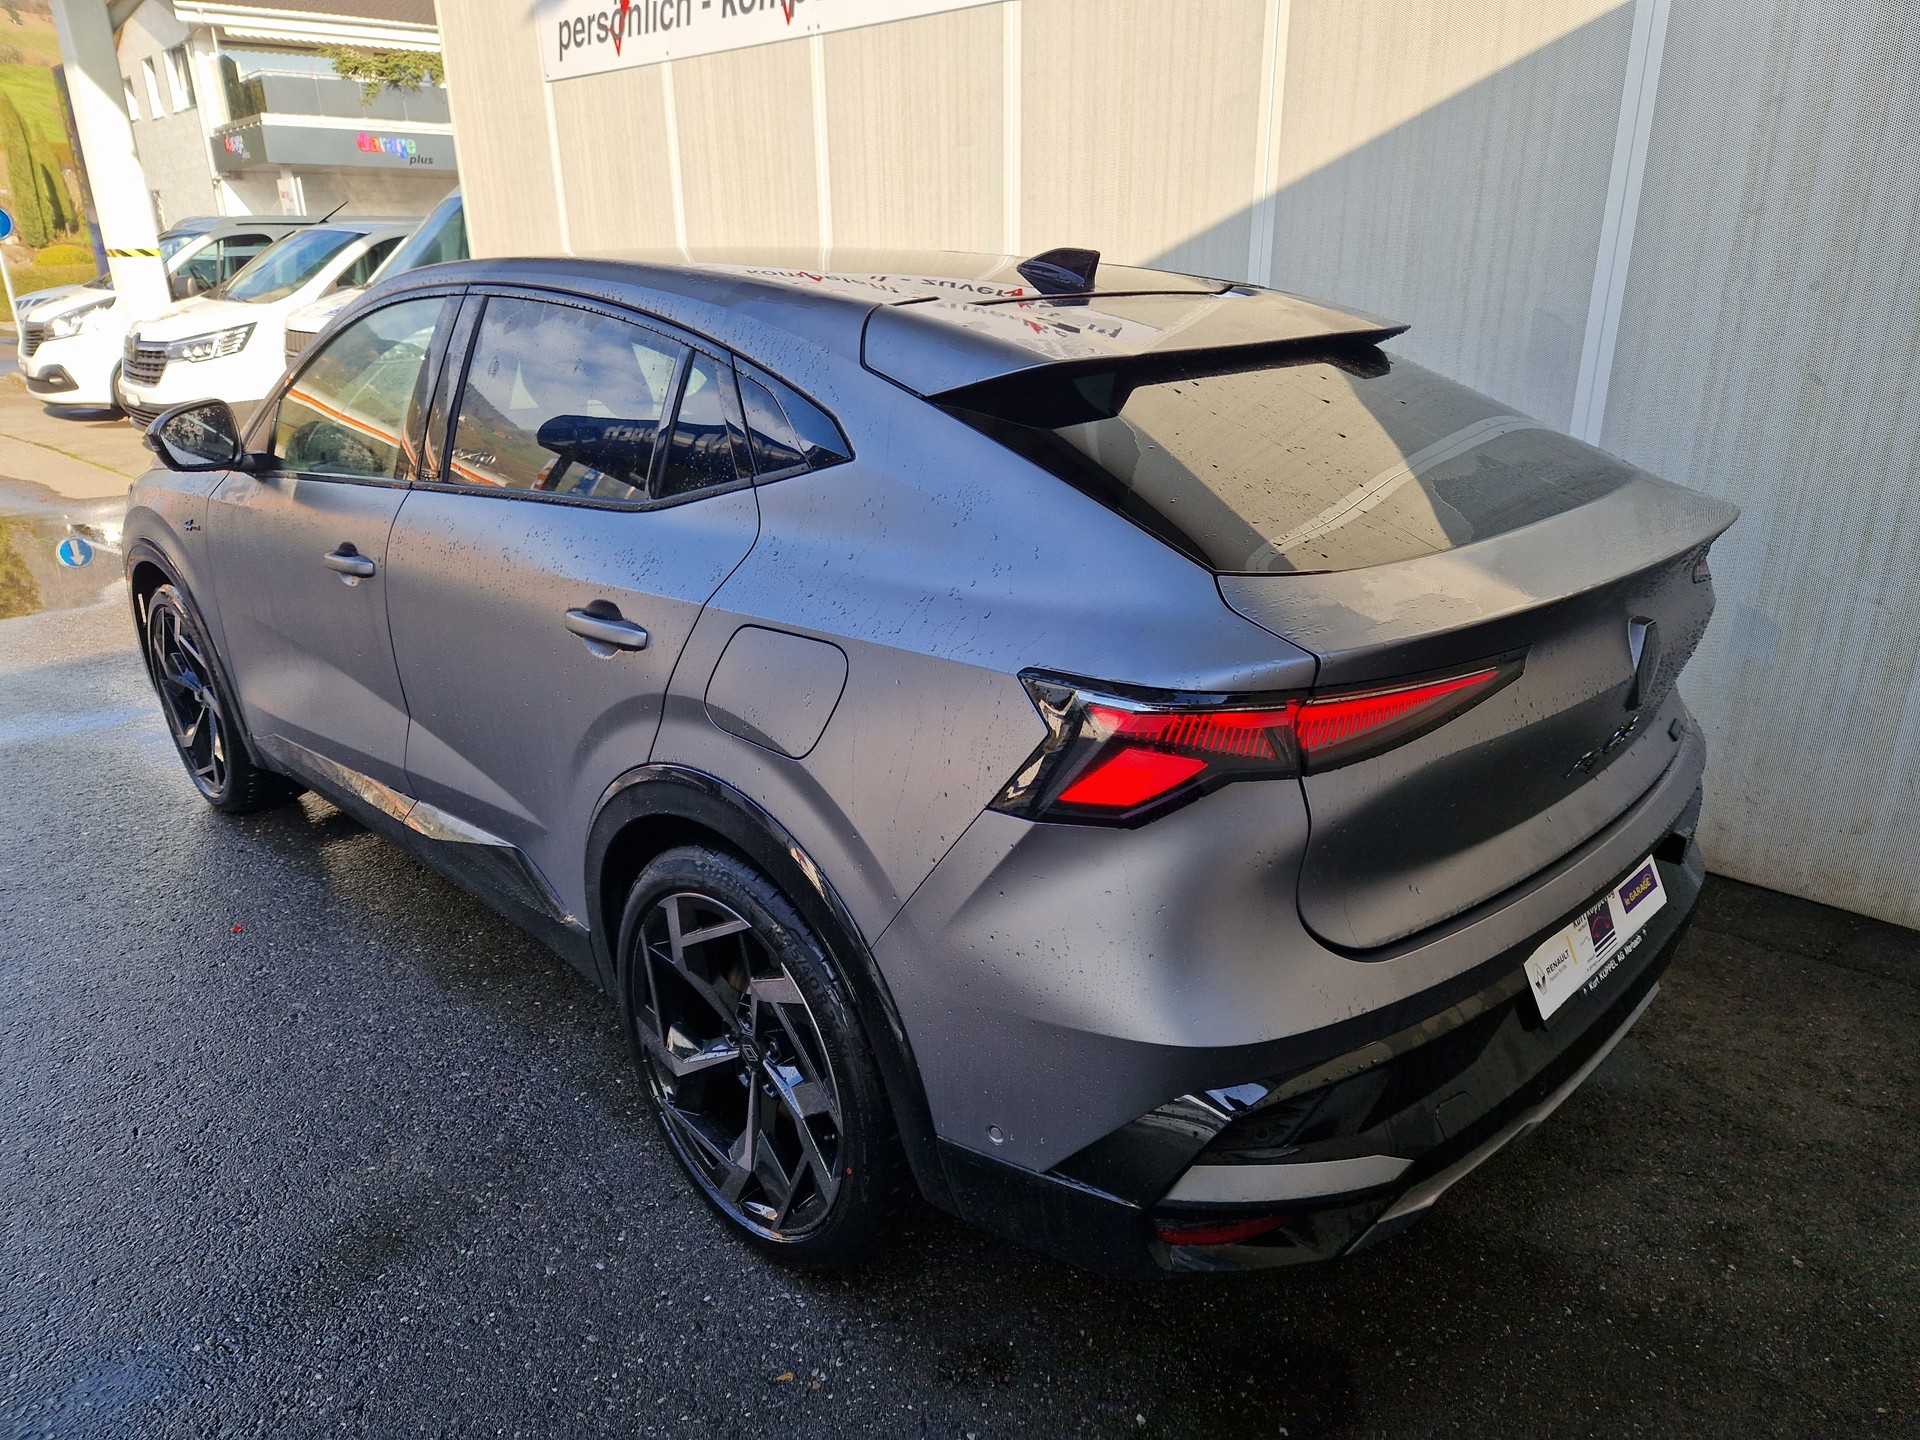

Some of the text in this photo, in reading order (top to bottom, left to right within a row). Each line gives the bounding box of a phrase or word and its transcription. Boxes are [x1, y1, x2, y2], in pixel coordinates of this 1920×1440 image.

[356, 132, 417, 159] Garage
[409, 155, 434, 165] plus
[1629, 880, 1651, 903] GARAGE
[1546, 949, 1570, 975] RENAULT
[1588, 976, 1600, 991] Kurt
[1616, 951, 1625, 963] AG
